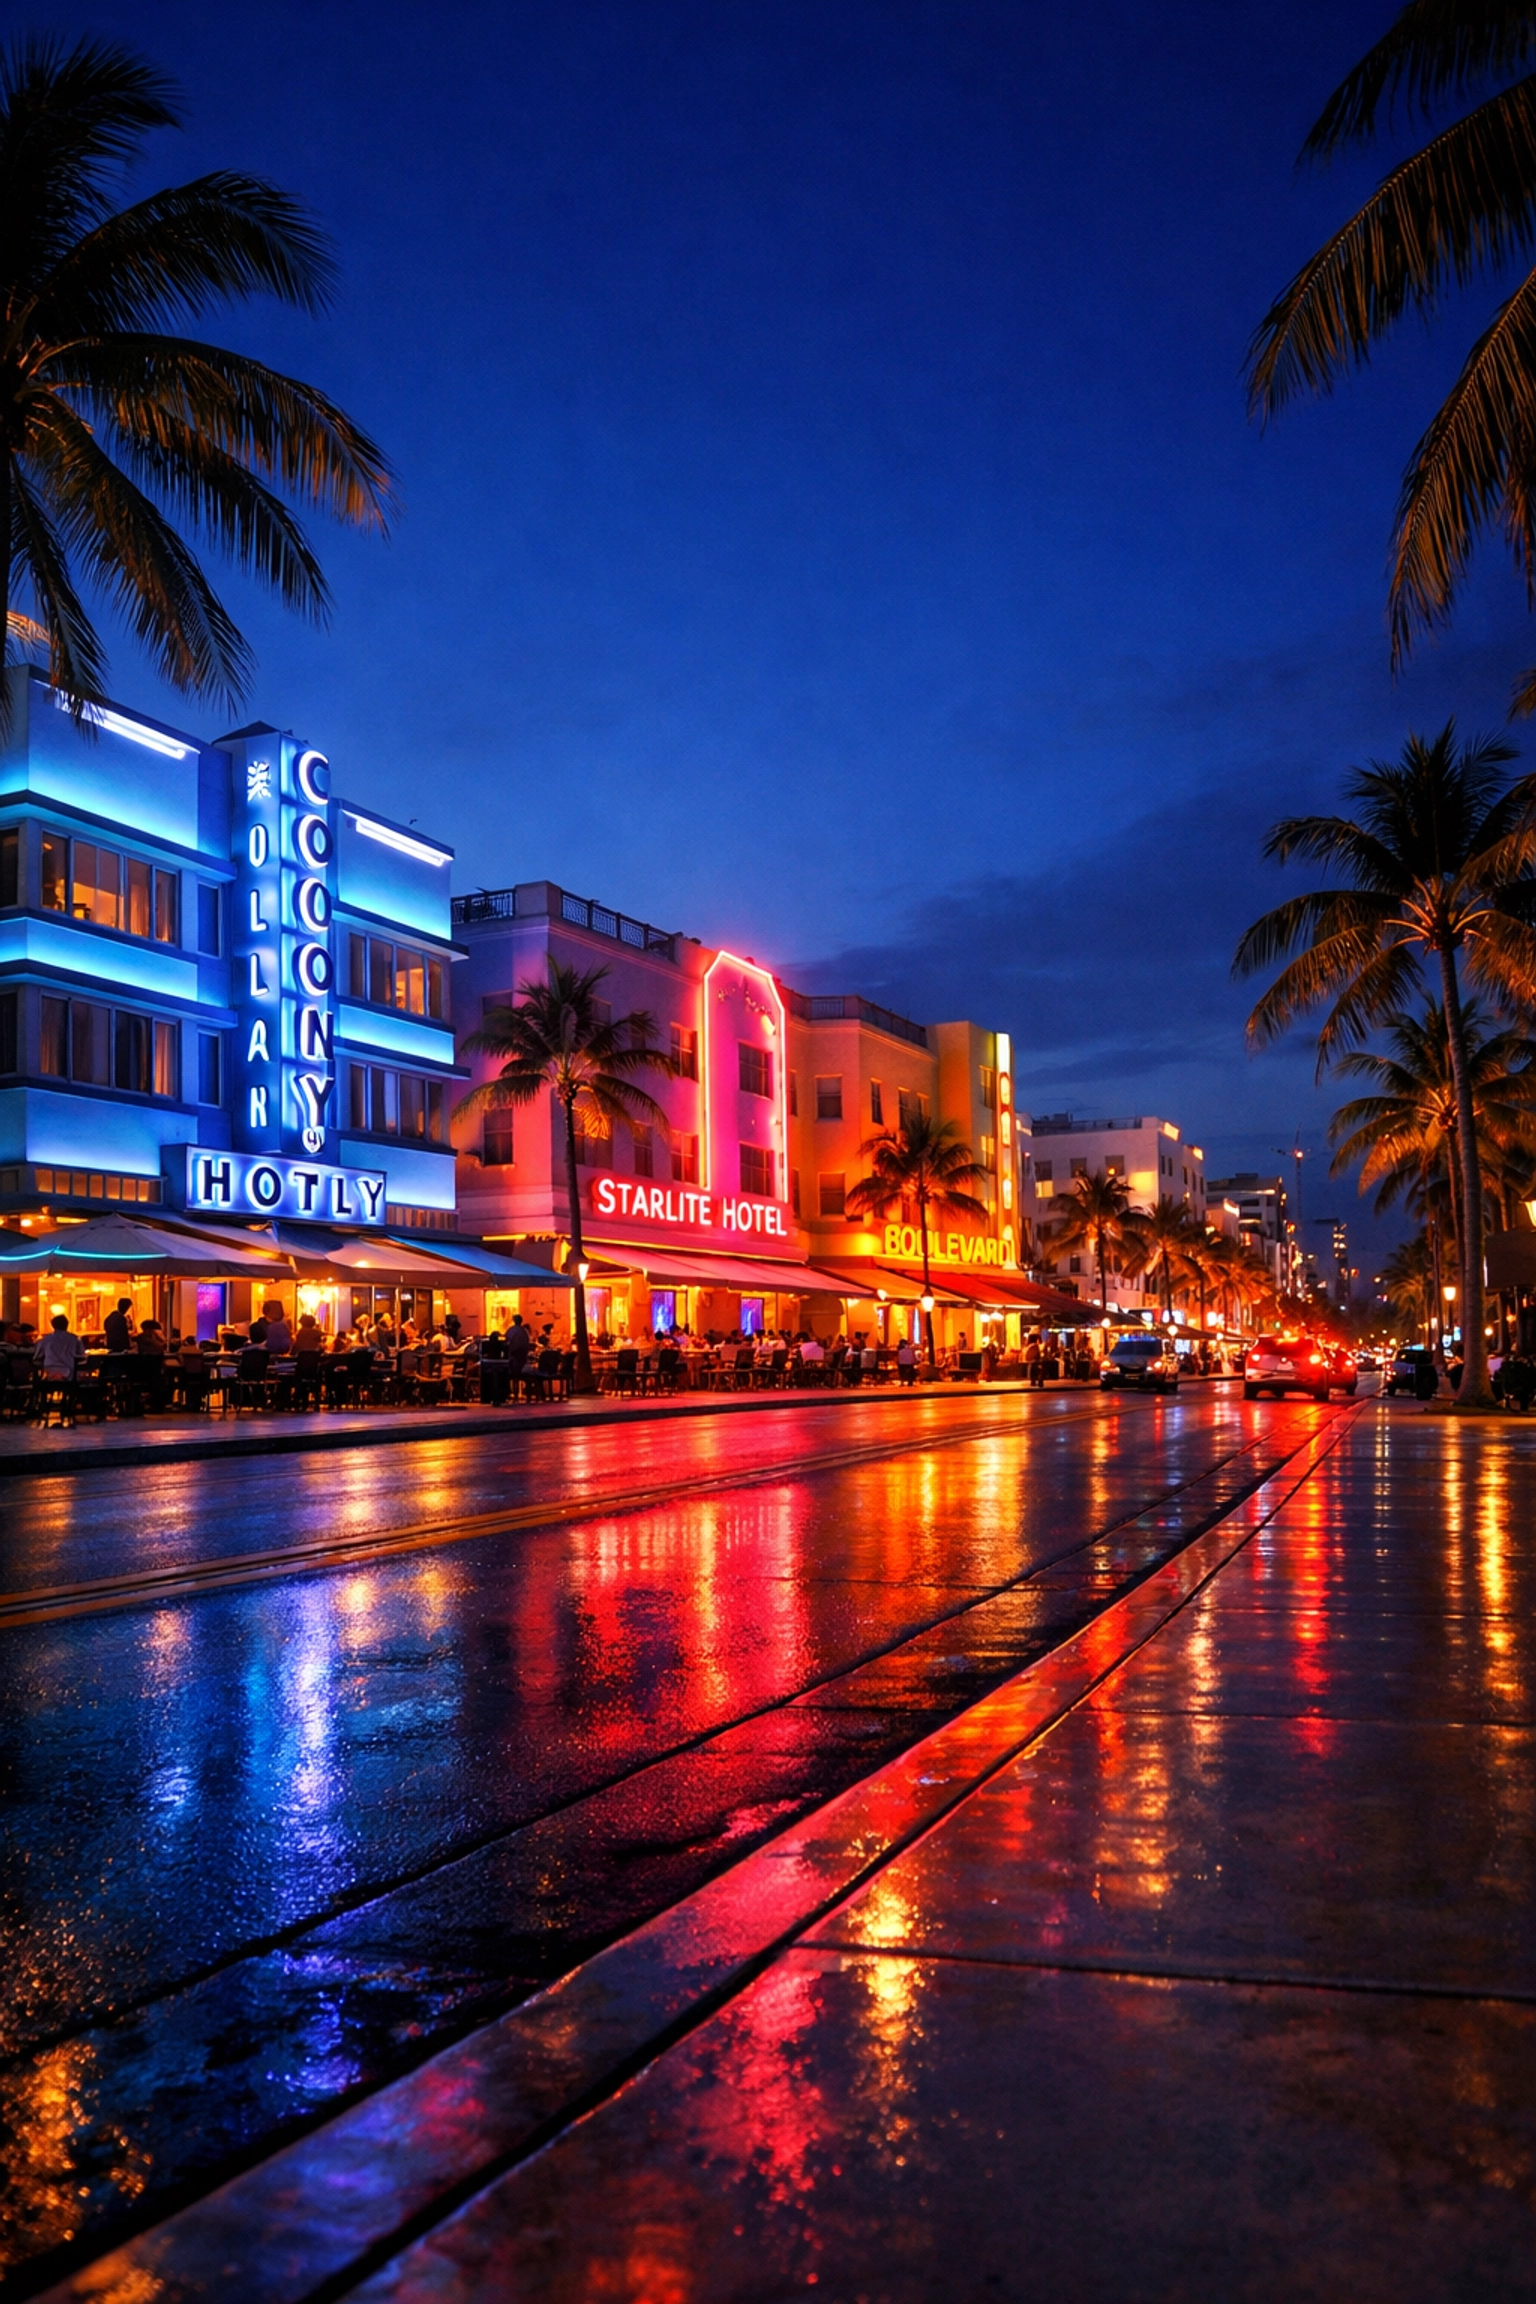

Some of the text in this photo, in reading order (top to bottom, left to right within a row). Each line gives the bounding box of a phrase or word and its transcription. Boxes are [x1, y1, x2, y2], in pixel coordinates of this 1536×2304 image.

[296, 750, 334, 1127] COOONY
[198, 1156, 384, 1220] HOTLY
[597, 1178, 788, 1236] STARLITE HOTEL
